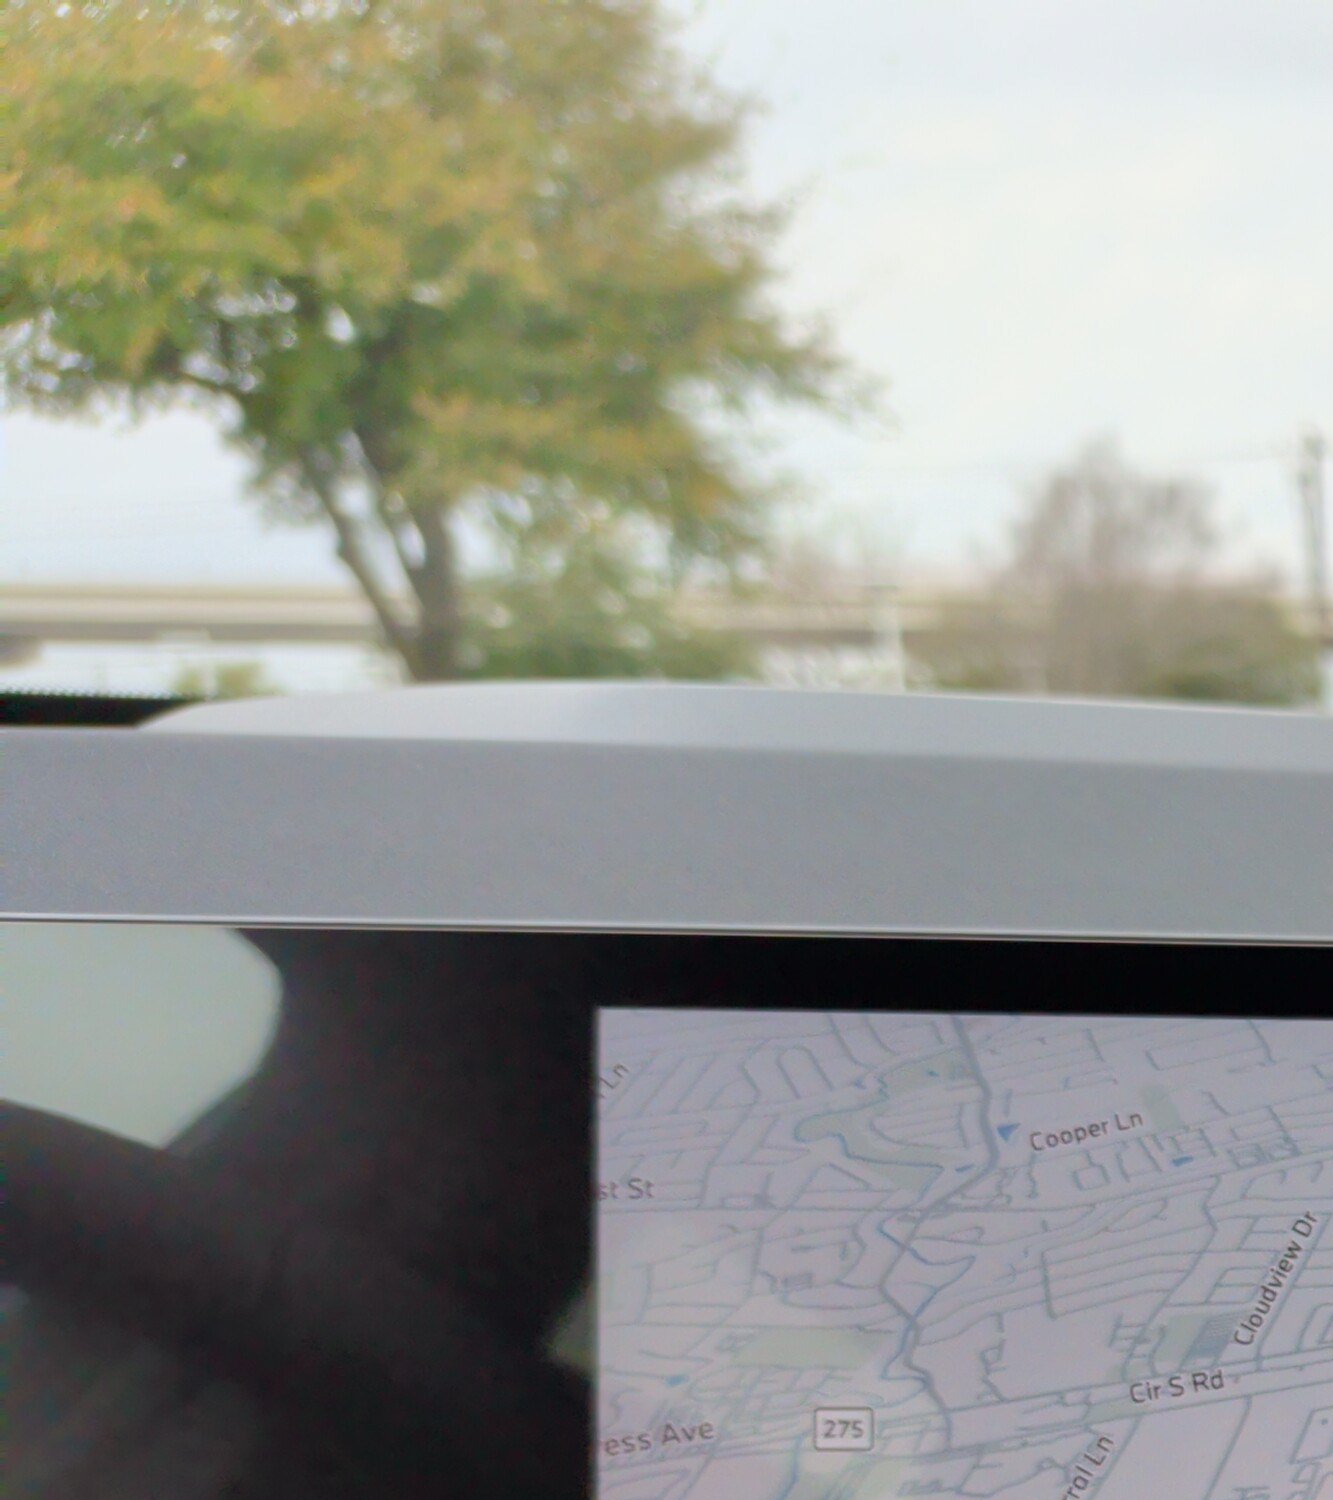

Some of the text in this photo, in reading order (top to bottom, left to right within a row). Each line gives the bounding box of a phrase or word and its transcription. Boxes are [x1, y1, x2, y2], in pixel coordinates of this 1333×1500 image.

[1030, 1111, 1143, 1151] Cooper Ln
[1234, 1211, 1319, 1346] Cloudview Dr
[1130, 1370, 1224, 1403] Cir S Rd
[661, 1420, 715, 1446] Ave
[823, 1419, 864, 1439] 275
[1087, 1434, 1114, 1464] Ln
